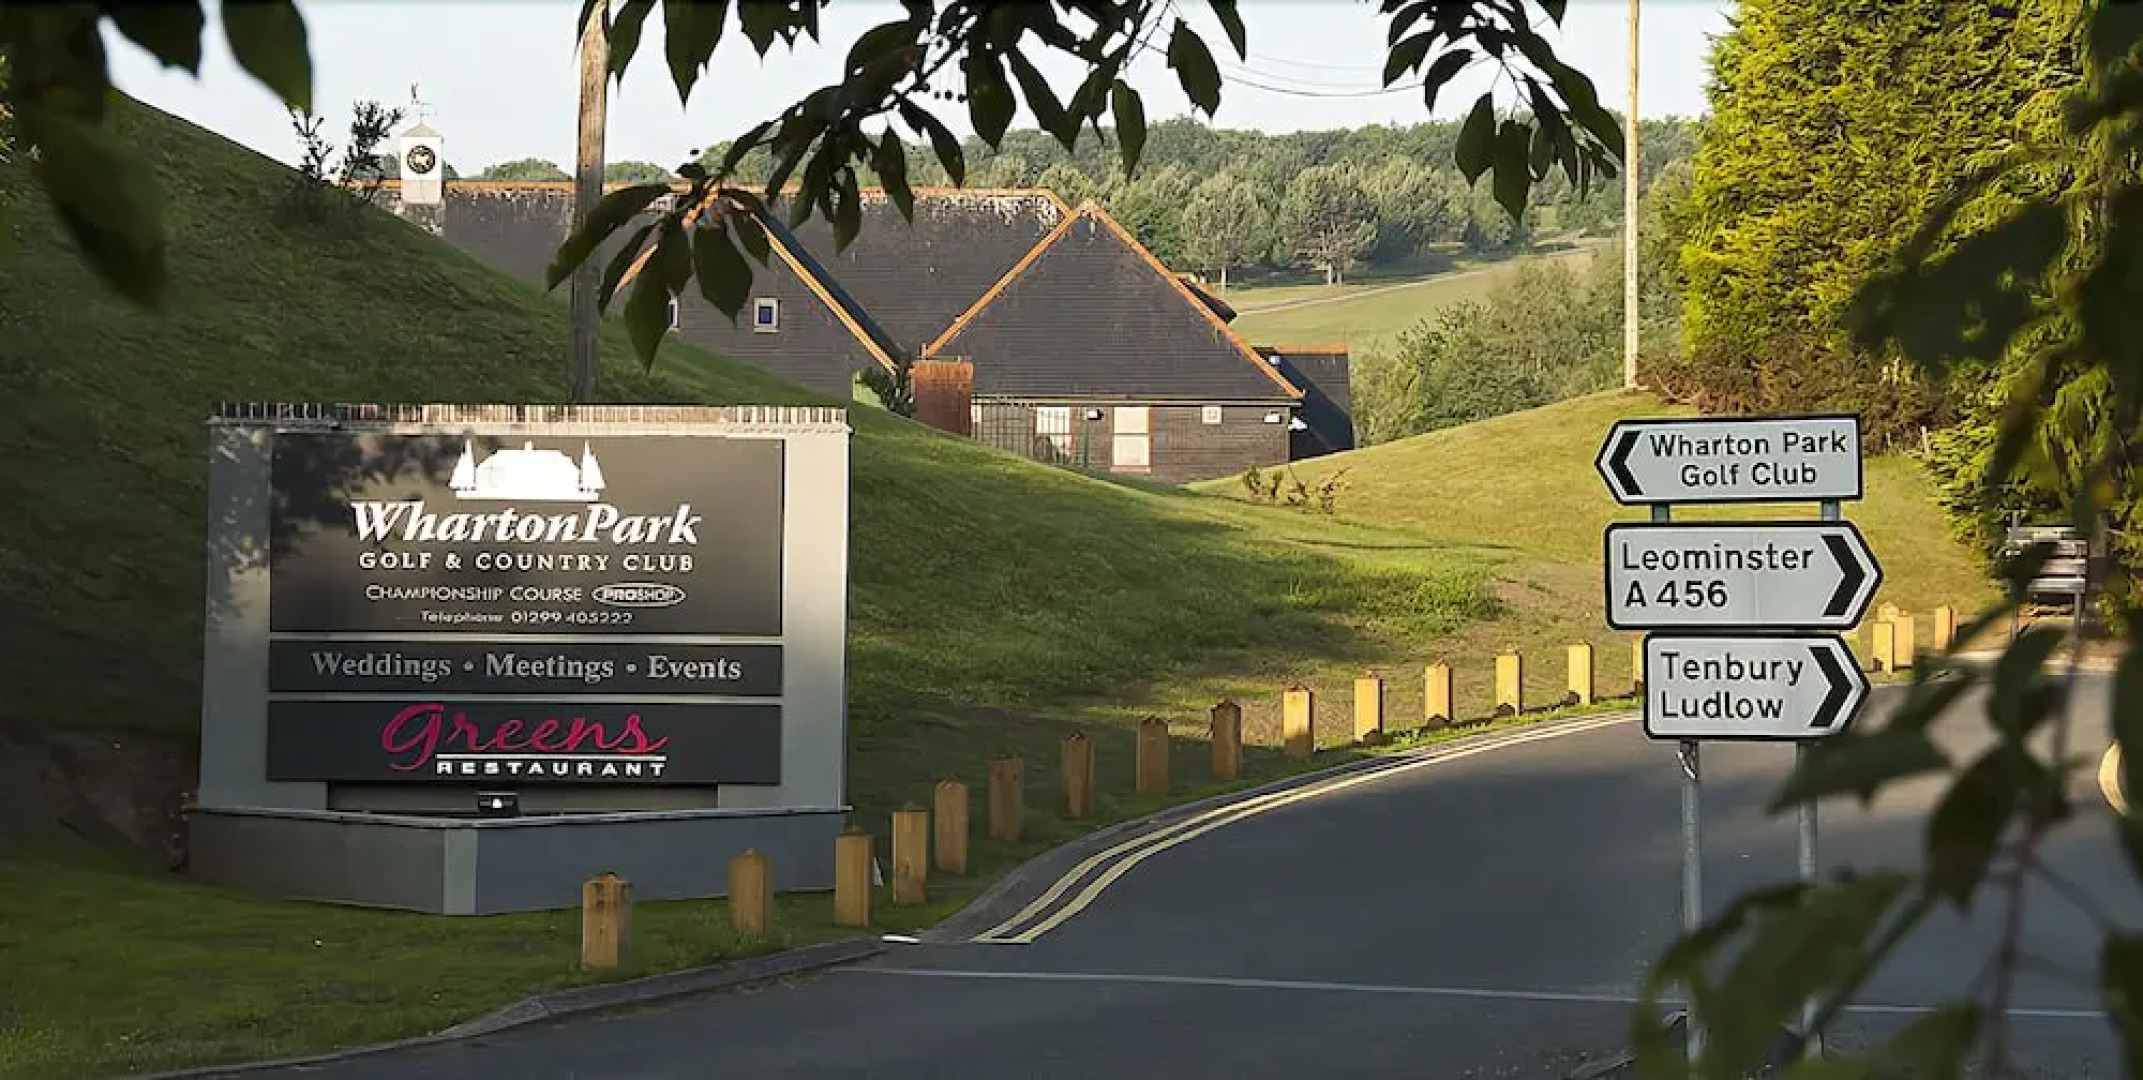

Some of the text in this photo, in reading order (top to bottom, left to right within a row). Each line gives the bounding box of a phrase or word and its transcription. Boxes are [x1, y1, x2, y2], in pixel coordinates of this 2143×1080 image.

[1649, 431, 1847, 457] Wharton Park
[1681, 463, 1817, 486] Golf Club
[359, 552, 694, 571] GOLF & COUNTRY CLUB
[1622, 542, 1813, 570] Leominster
[421, 611, 502, 625] Telephone
[312, 652, 742, 683] Weddings Meetings Events
[1660, 652, 1803, 686] Tenbury
[1661, 691, 1784, 719] Ludlow
[436, 762, 666, 776] RESTAURANT
